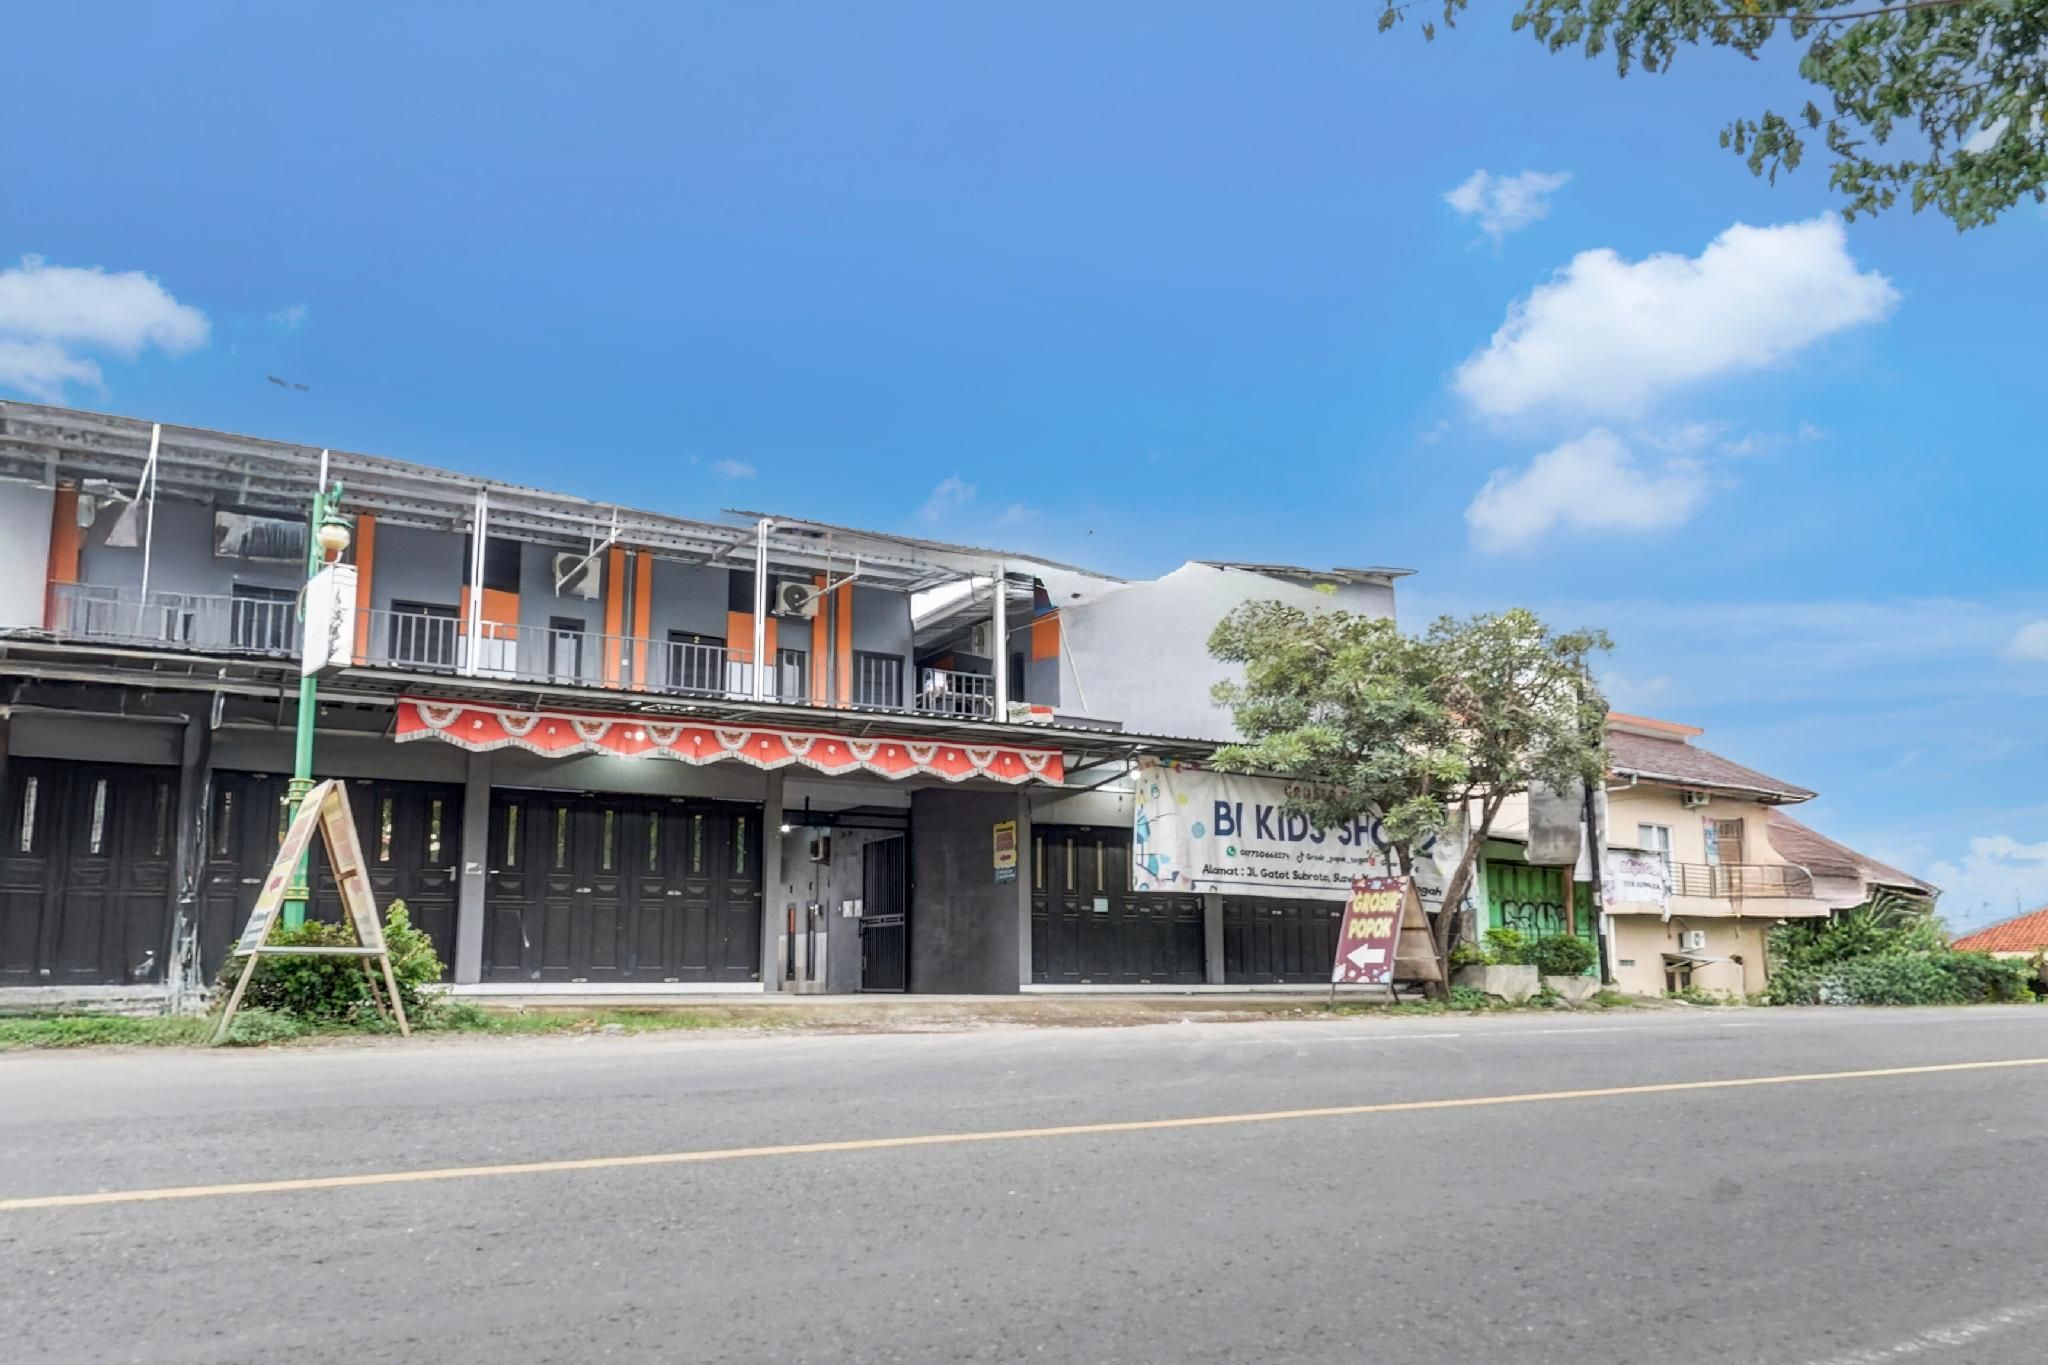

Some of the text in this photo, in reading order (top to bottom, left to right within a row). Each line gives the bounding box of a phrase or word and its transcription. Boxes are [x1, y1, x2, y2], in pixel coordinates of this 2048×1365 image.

[1214, 800, 1243, 838] BI
[1202, 863, 1239, 876] Alamat
[1260, 868, 1290, 880] Gatot
[1347, 917, 1394, 939] POPOK
